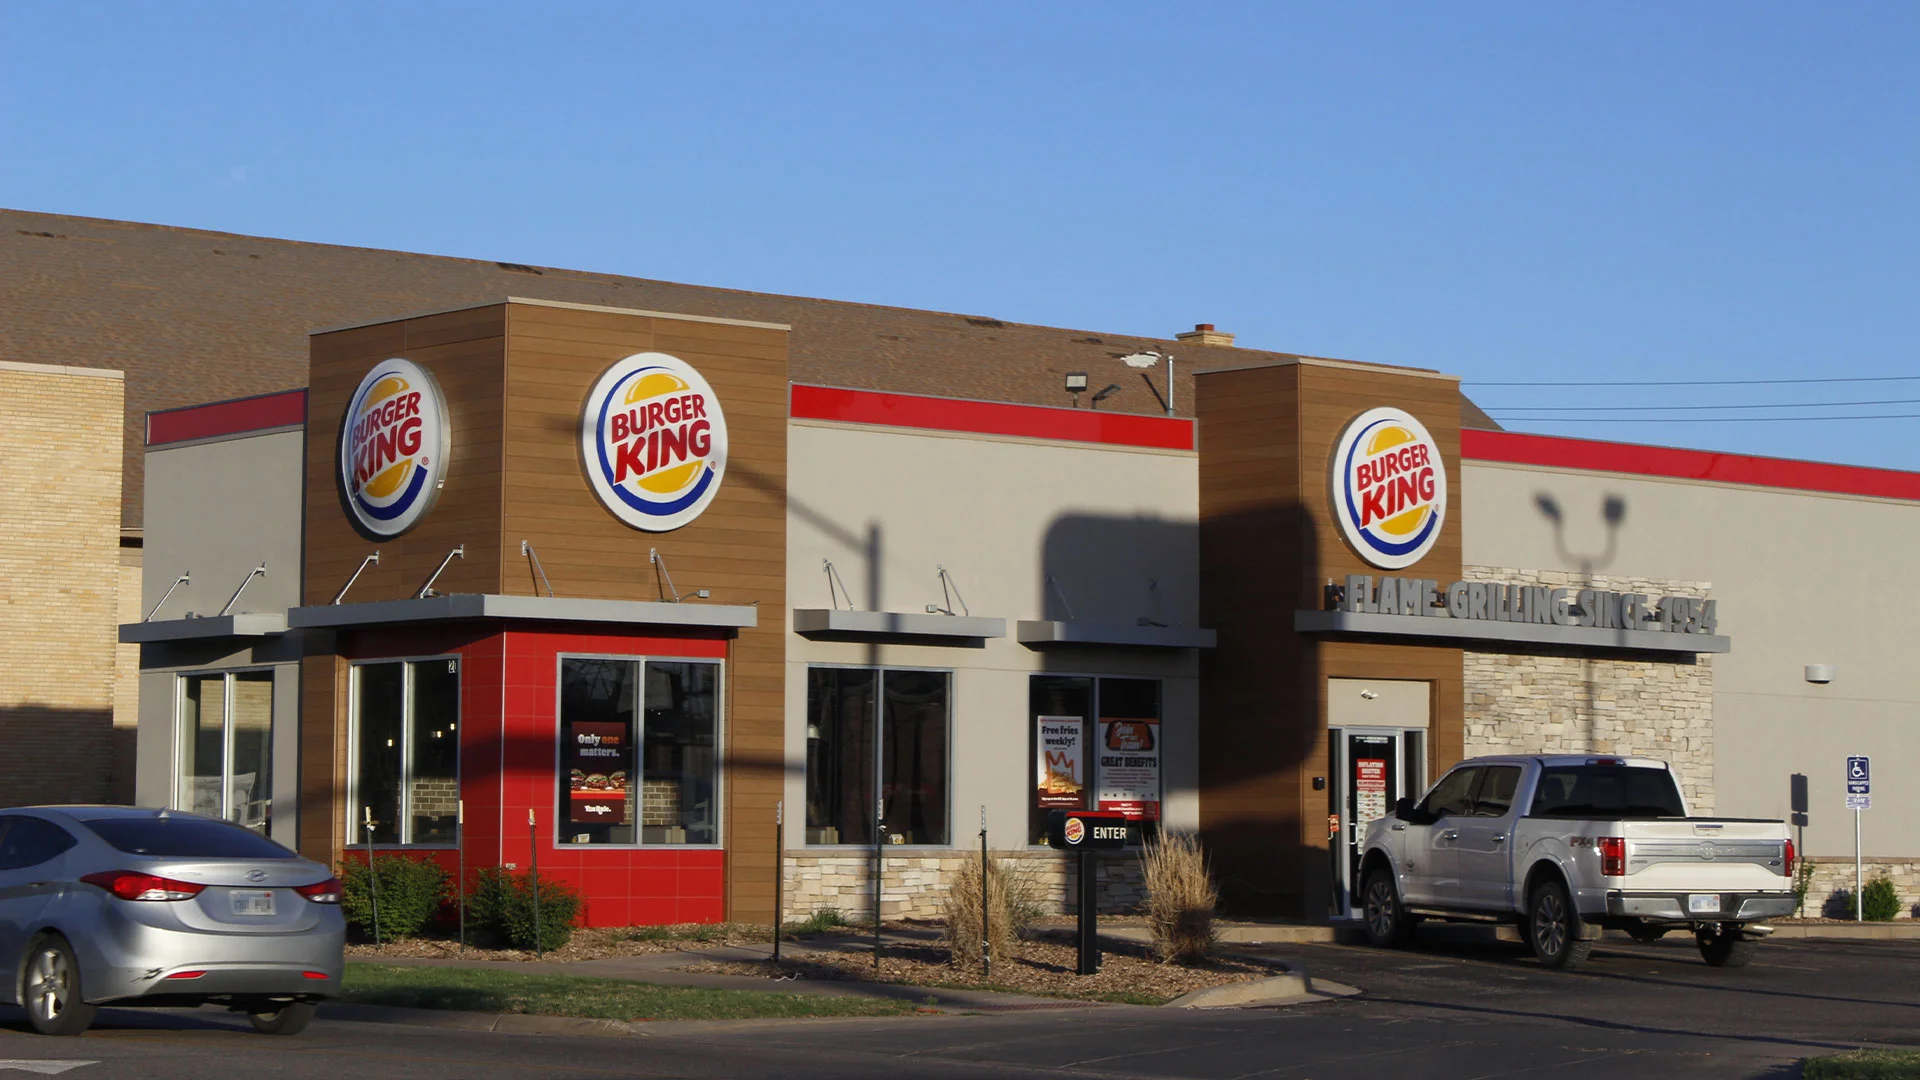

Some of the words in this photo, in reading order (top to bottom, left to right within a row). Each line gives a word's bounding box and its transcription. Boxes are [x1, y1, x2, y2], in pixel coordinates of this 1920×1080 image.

[353, 392, 421, 453] BURGER
[611, 393, 707, 444] BURGER
[354, 417, 422, 492] KING
[614, 419, 711, 484] KING
[1357, 443, 1430, 492] BURGER
[1360, 467, 1435, 527] KING
[1345, 574, 1437, 616] FLAME
[1445, 581, 1569, 625] GRILLING
[1580, 589, 1648, 630] SINCE
[1659, 595, 1718, 635] 1954
[577, 733, 600, 746] Only
[601, 736, 619, 744] one
[1042, 725, 1059, 735] Free
[1060, 725, 1079, 735] fries
[1045, 737, 1076, 747] weekly!
[580, 747, 620, 757] matters.
[1101, 756, 1123, 767] GREAT
[1124, 757, 1157, 768] BENEFITS
[1067, 827, 1082, 837] KING
[1094, 827, 1127, 839] ENTER
